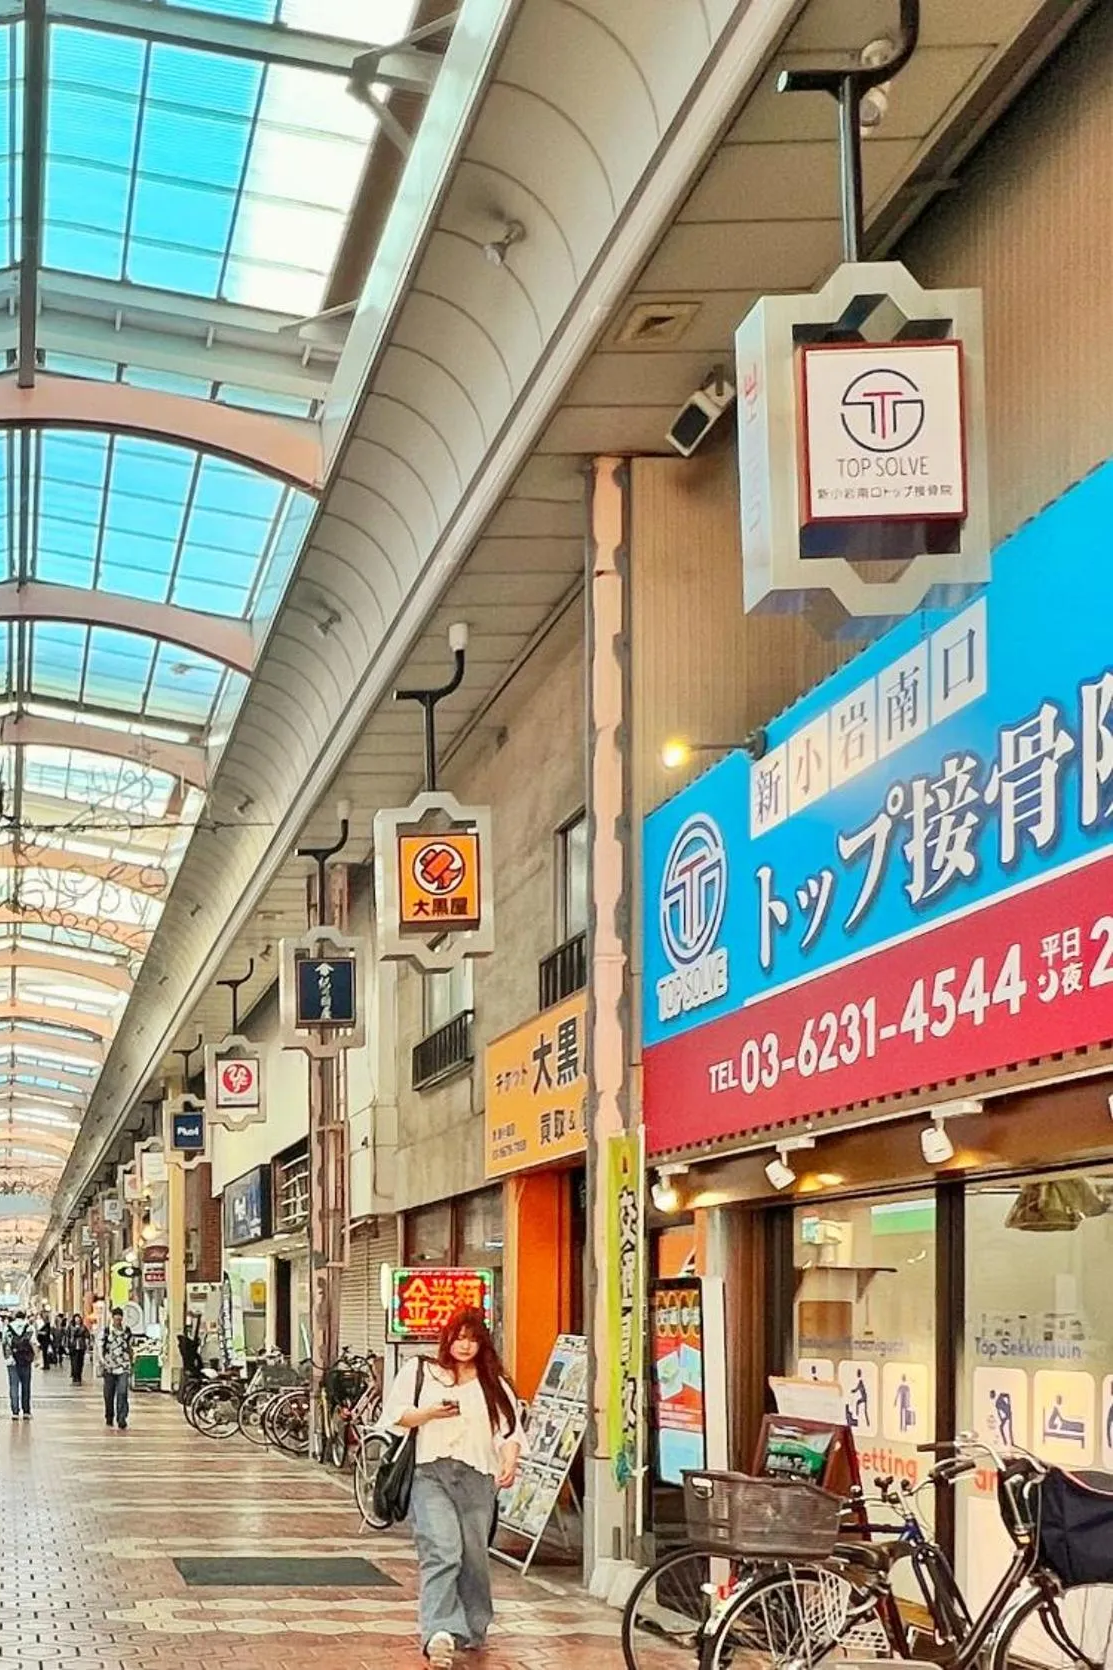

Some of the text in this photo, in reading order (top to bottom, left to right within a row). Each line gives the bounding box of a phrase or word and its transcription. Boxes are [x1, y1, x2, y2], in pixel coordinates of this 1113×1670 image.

[837, 456, 930, 478] TOP SOLVE
[817, 484, 953, 500] 新小岩南口トップ接骨院
[756, 628, 975, 824] 新小岩南口
[413, 896, 468, 917] 大黒屋
[1040, 927, 1082, 967] 平日
[709, 944, 1027, 1095] TEL 03-6231-4544
[532, 1011, 587, 1096] 大黒
[975, 1336, 999, 1361] Top
